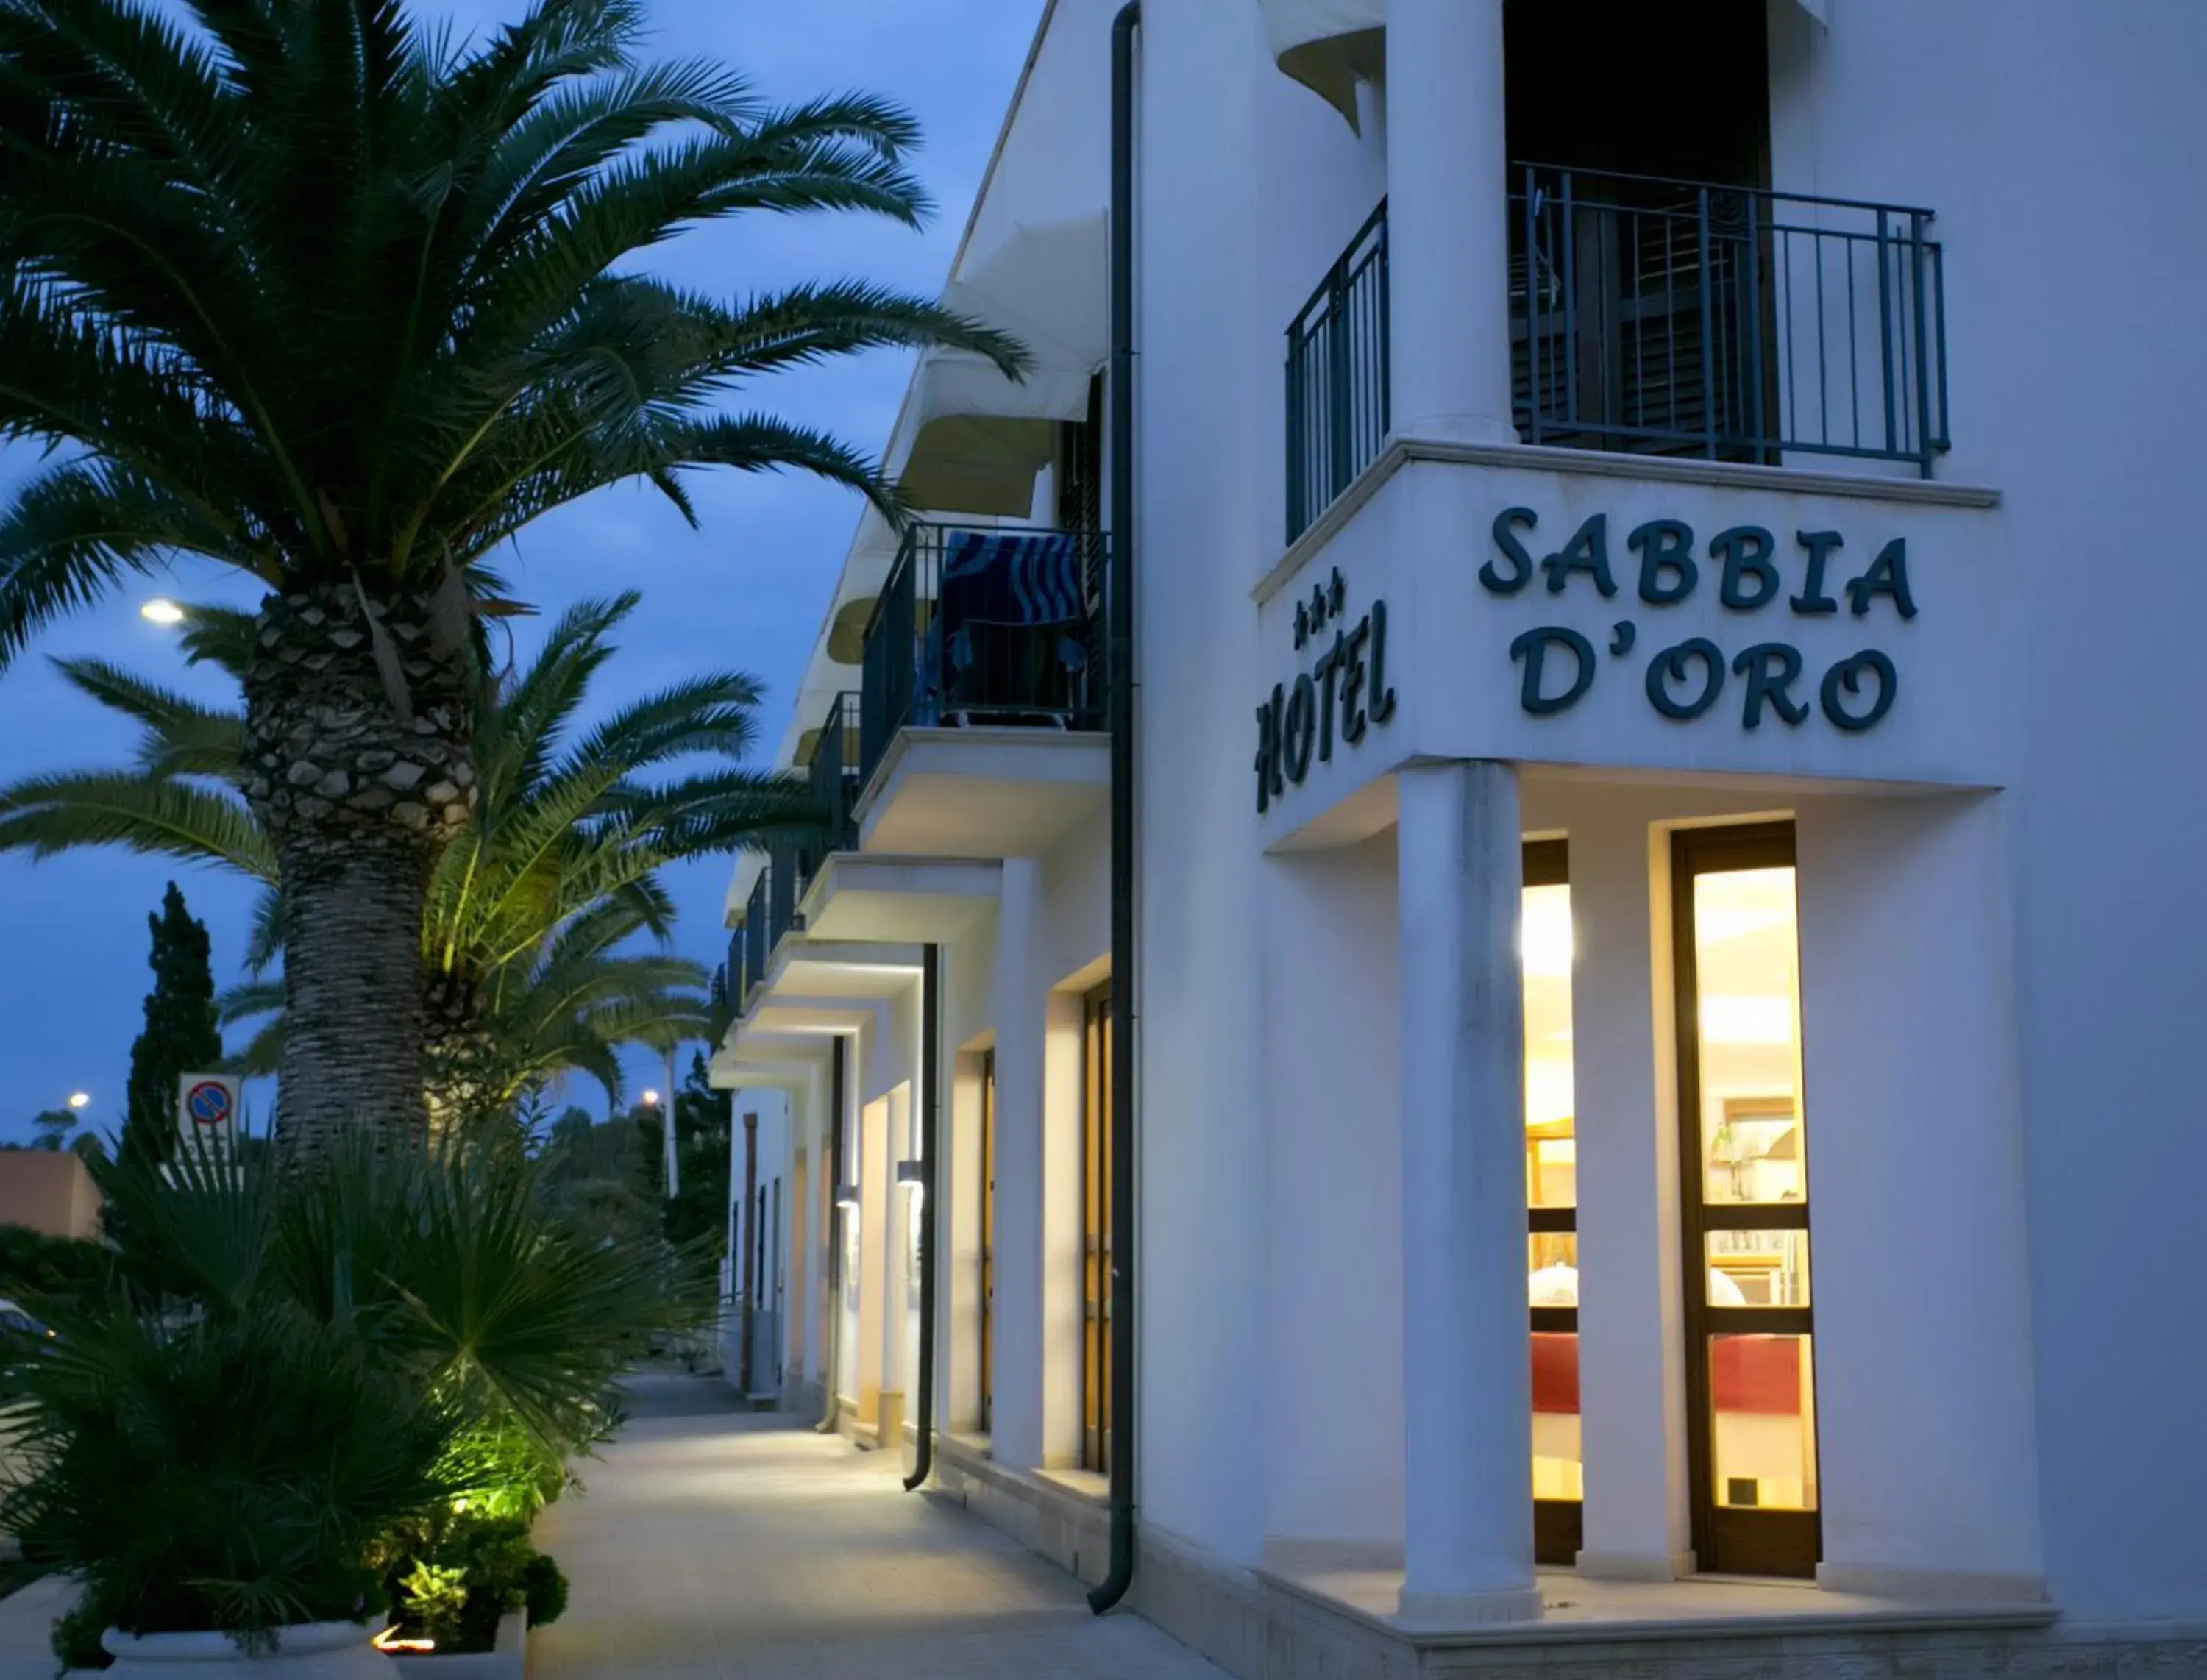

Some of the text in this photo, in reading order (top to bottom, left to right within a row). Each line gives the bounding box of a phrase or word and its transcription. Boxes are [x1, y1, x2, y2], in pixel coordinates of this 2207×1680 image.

[1478, 507, 1918, 619] SABBIA
[1254, 599, 1396, 814] HOTEL
[1510, 620, 1897, 730] D'ORO
